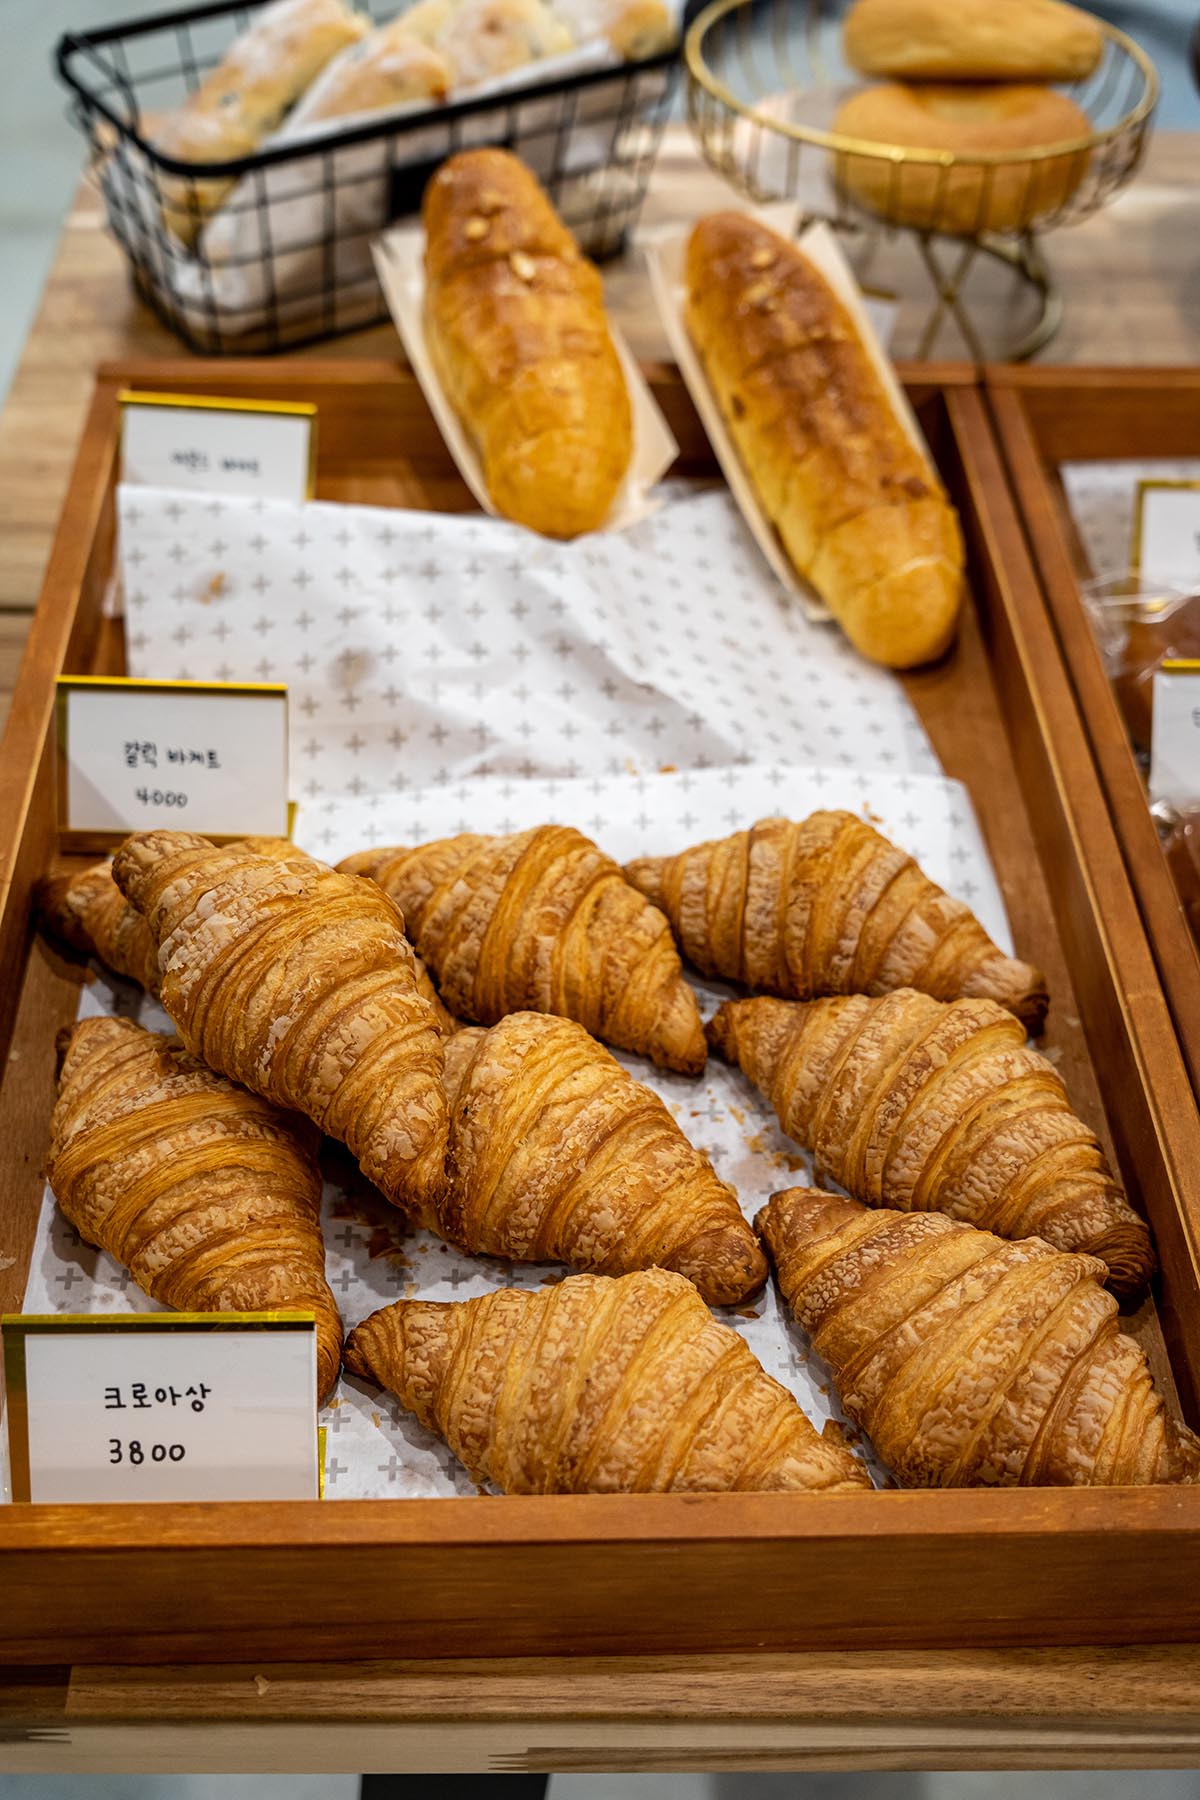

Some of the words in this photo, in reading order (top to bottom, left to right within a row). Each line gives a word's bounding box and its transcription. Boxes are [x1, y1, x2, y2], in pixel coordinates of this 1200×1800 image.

[136, 788, 188, 808] 4000
[105, 1383, 211, 1412] 크로아상
[109, 1439, 185, 1465] 3800
